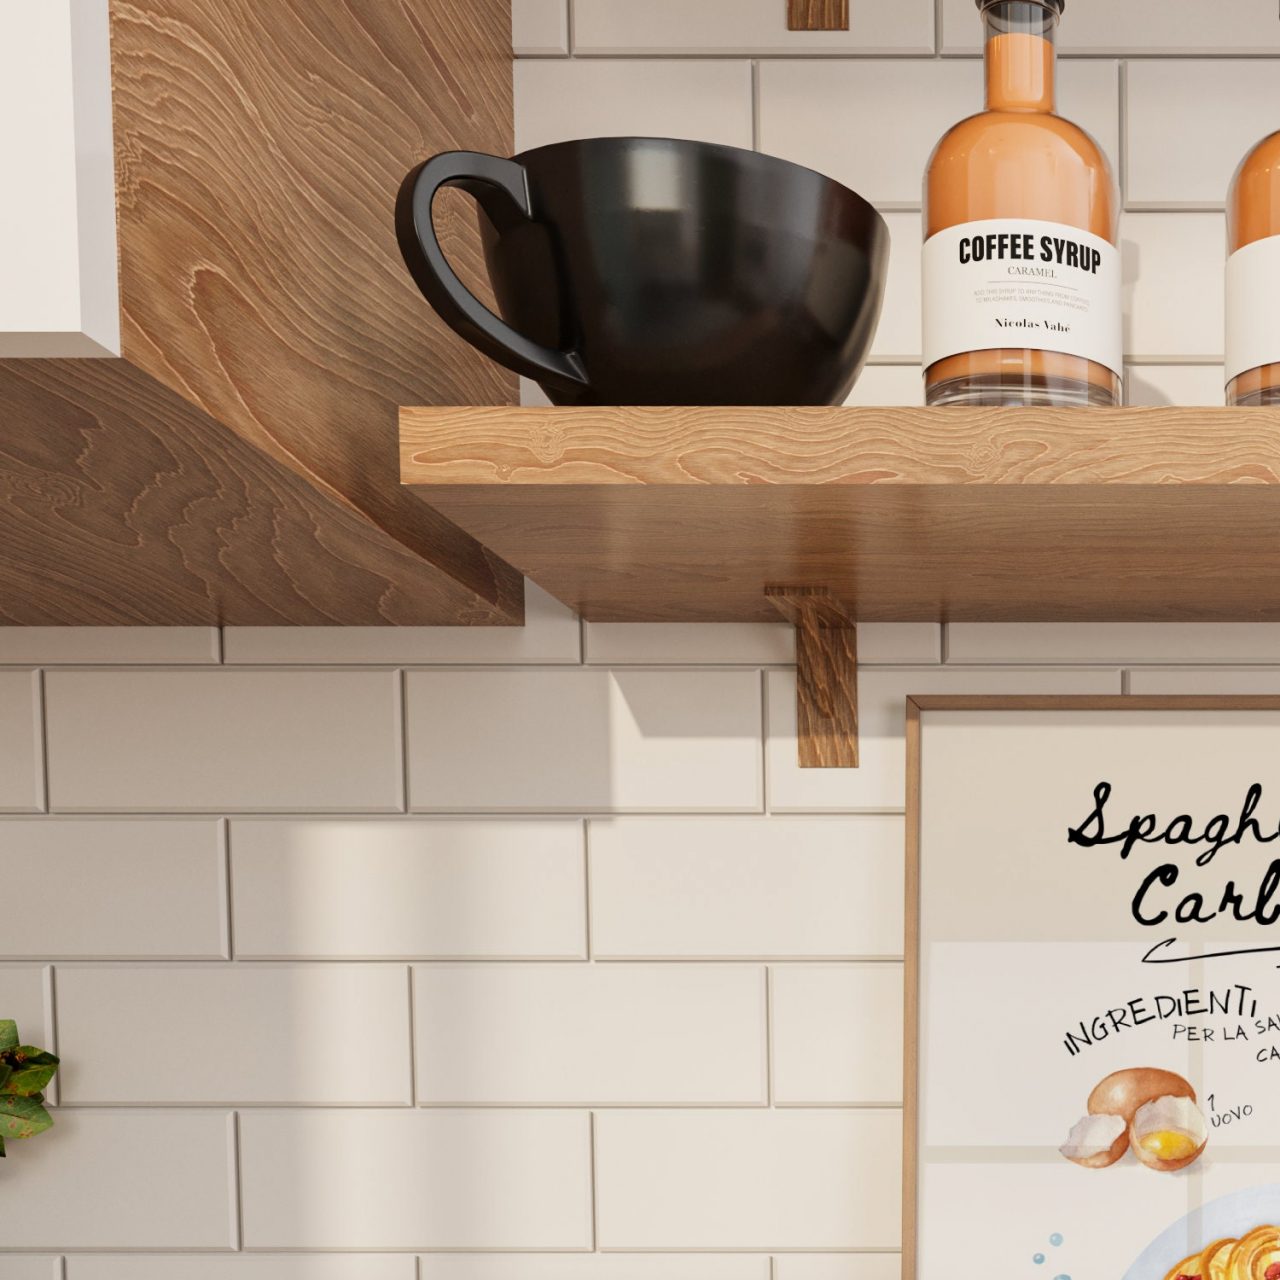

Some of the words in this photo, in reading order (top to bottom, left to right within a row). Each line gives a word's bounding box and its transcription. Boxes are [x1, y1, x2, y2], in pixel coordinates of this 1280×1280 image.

[959, 234, 1034, 264] COFFEE
[1040, 236, 1101, 274] SYRUP
[1008, 266, 1057, 279] CARAMEL
[995, 318, 1039, 328] Nicolas
[1064, 984, 1257, 1056] INGREDIENTI
[1173, 1024, 1215, 1042] PER
[1223, 1025, 1249, 1041] LA
[1208, 1094, 1215, 1111] 1
[1211, 1104, 1253, 1127] UOVO
